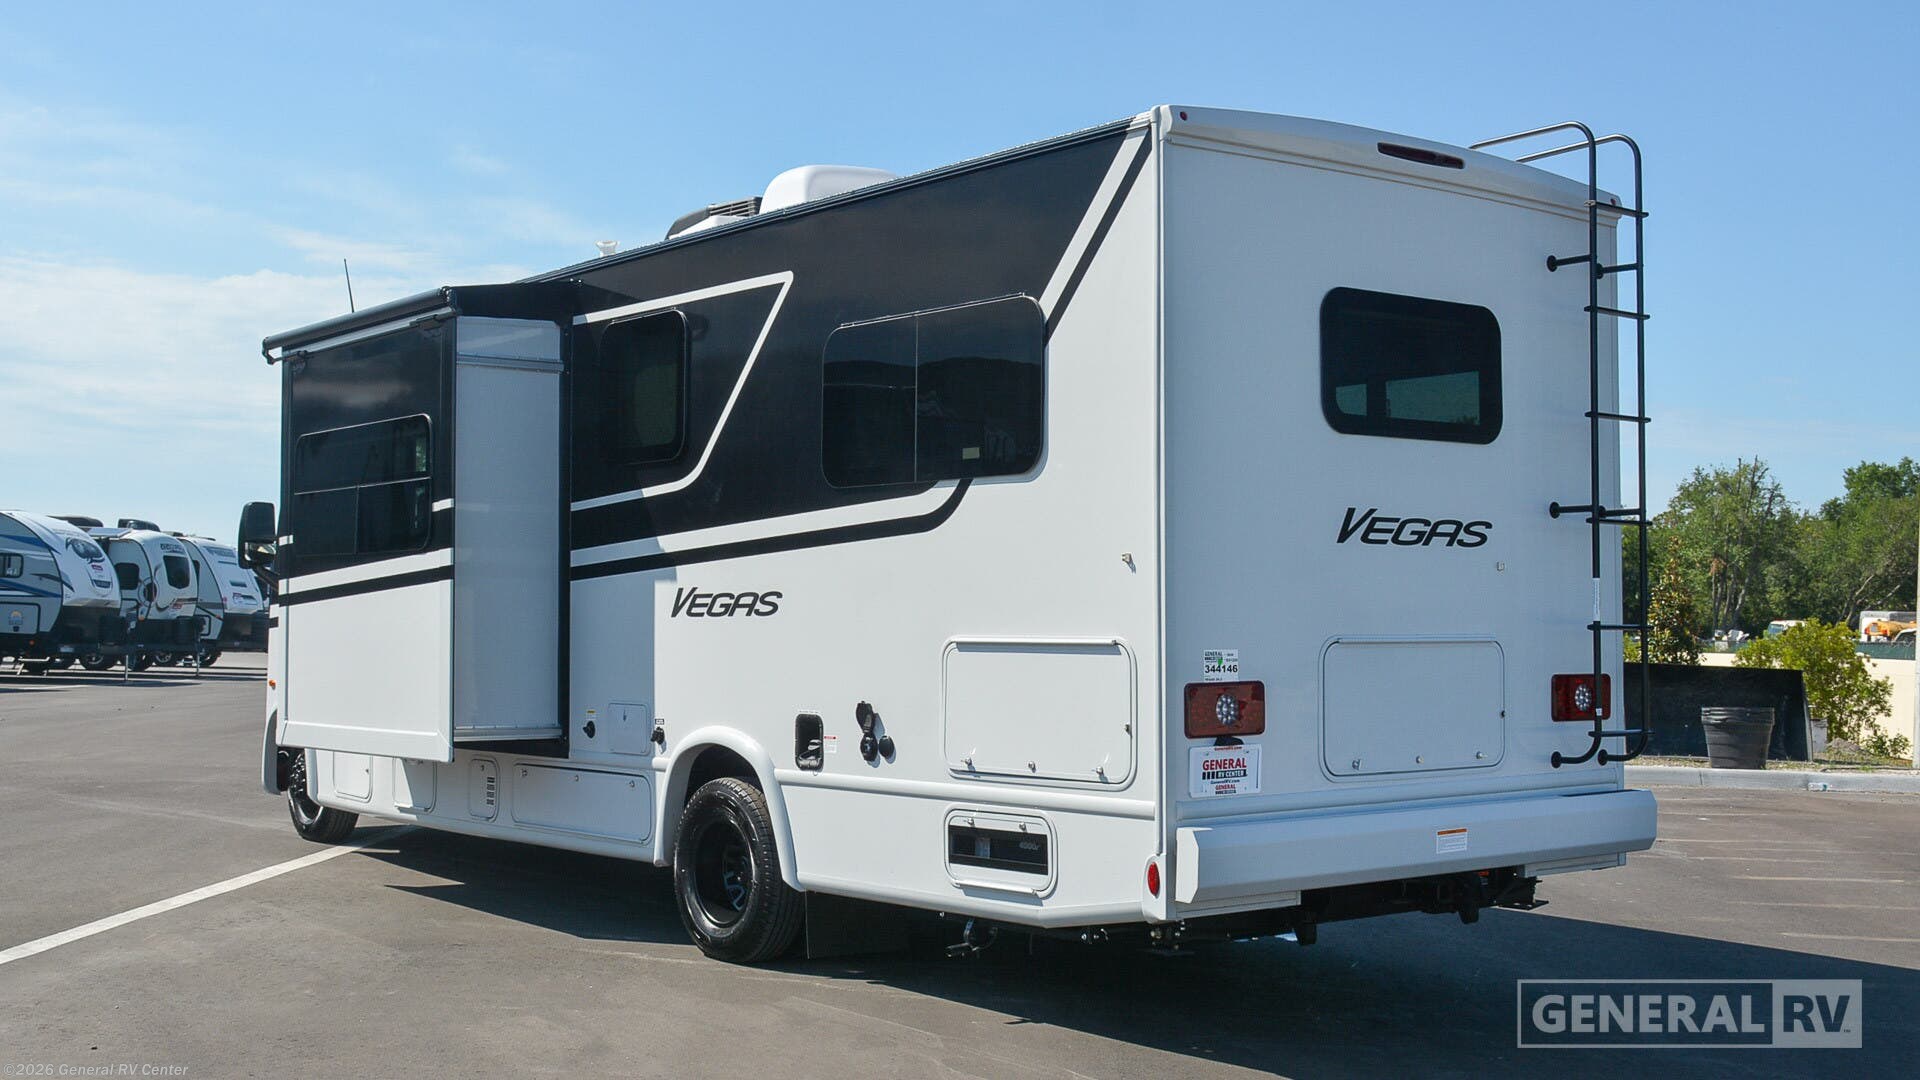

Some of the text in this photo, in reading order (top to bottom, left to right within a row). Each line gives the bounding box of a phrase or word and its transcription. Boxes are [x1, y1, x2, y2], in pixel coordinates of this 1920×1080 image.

[1336, 507, 1493, 548] VEGAS
[671, 587, 783, 618] VEGAS
[1205, 664, 1238, 673] 344146
[1203, 758, 1247, 771] GENERAL
[1225, 769, 1244, 777] CENTER
